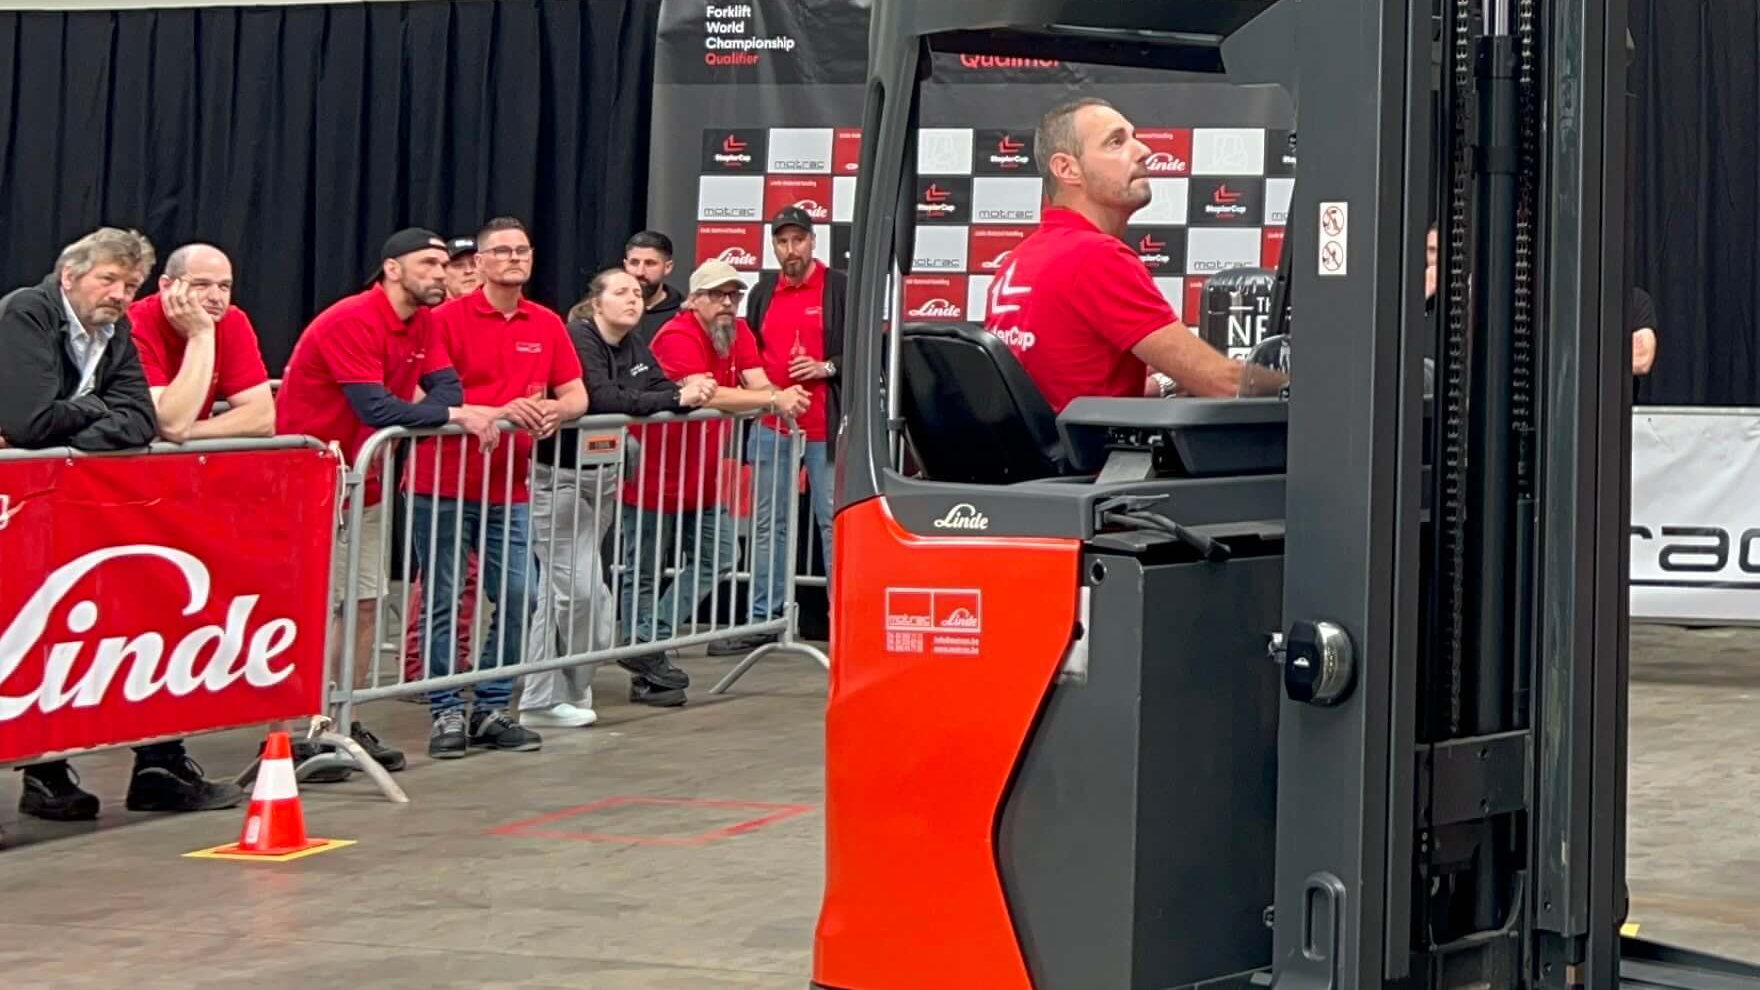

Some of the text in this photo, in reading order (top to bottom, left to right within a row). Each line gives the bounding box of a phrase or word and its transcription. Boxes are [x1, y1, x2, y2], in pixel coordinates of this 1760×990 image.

[706, 4, 752, 18] Forklift
[706, 21, 745, 33] World
[705, 37, 796, 52] Championship
[705, 53, 759, 66] Qualifier
[908, 298, 961, 317] Linde
[934, 503, 989, 530] Linde
